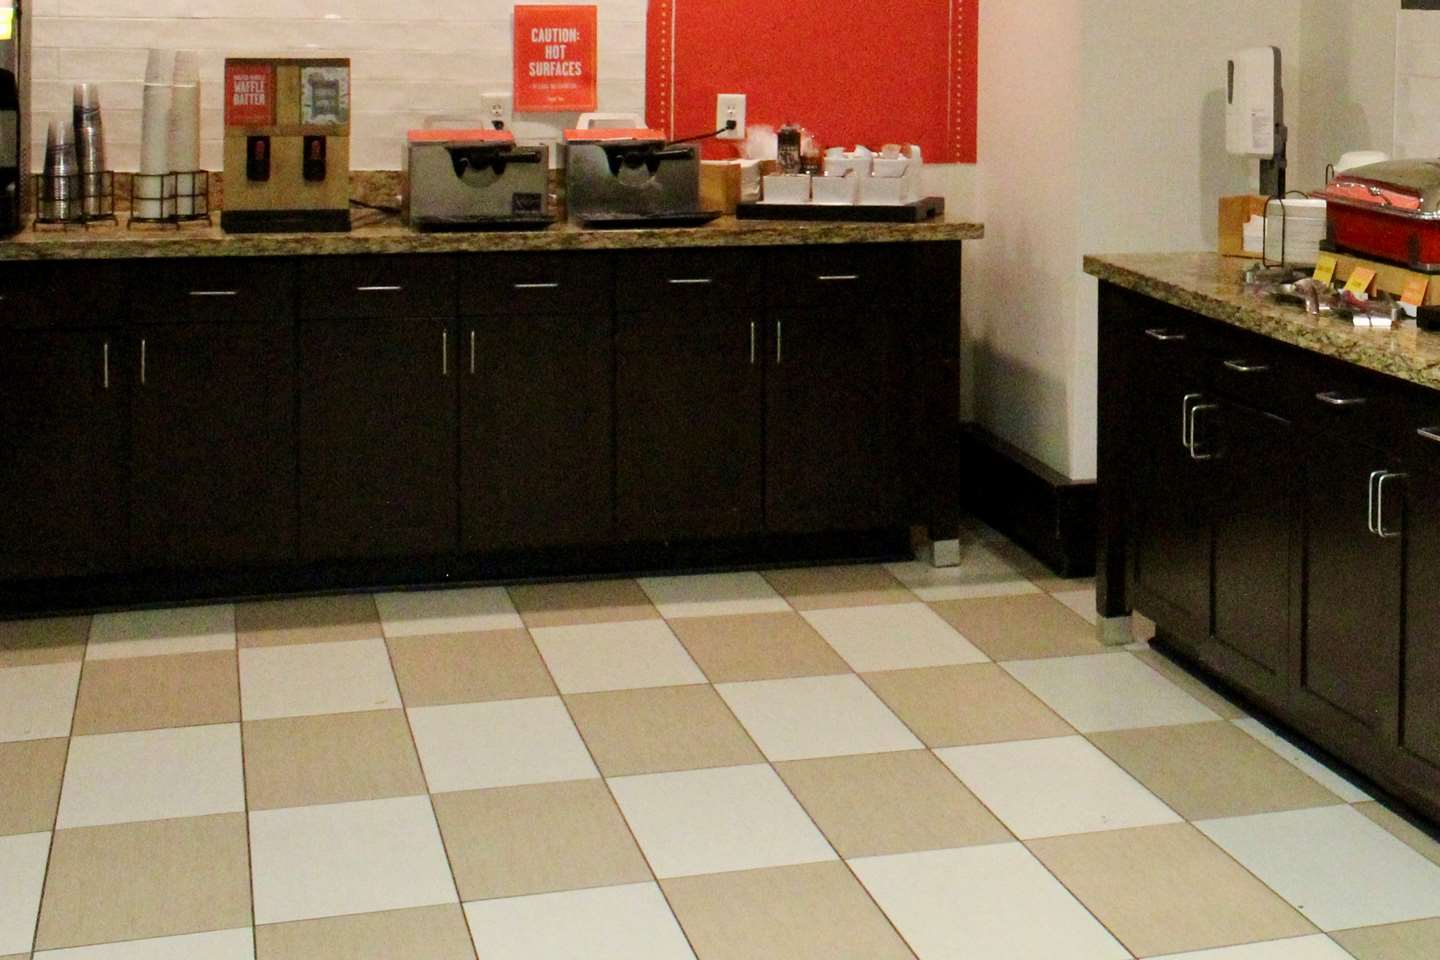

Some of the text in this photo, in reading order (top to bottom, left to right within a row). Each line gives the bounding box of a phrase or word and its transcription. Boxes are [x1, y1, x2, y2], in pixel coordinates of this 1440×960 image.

[531, 28, 581, 43] CAUTION:
[544, 44, 567, 60] HOT
[528, 61, 583, 77] SURFACES
[233, 80, 265, 93] WAFFLE
[233, 93, 265, 106] BATTER
